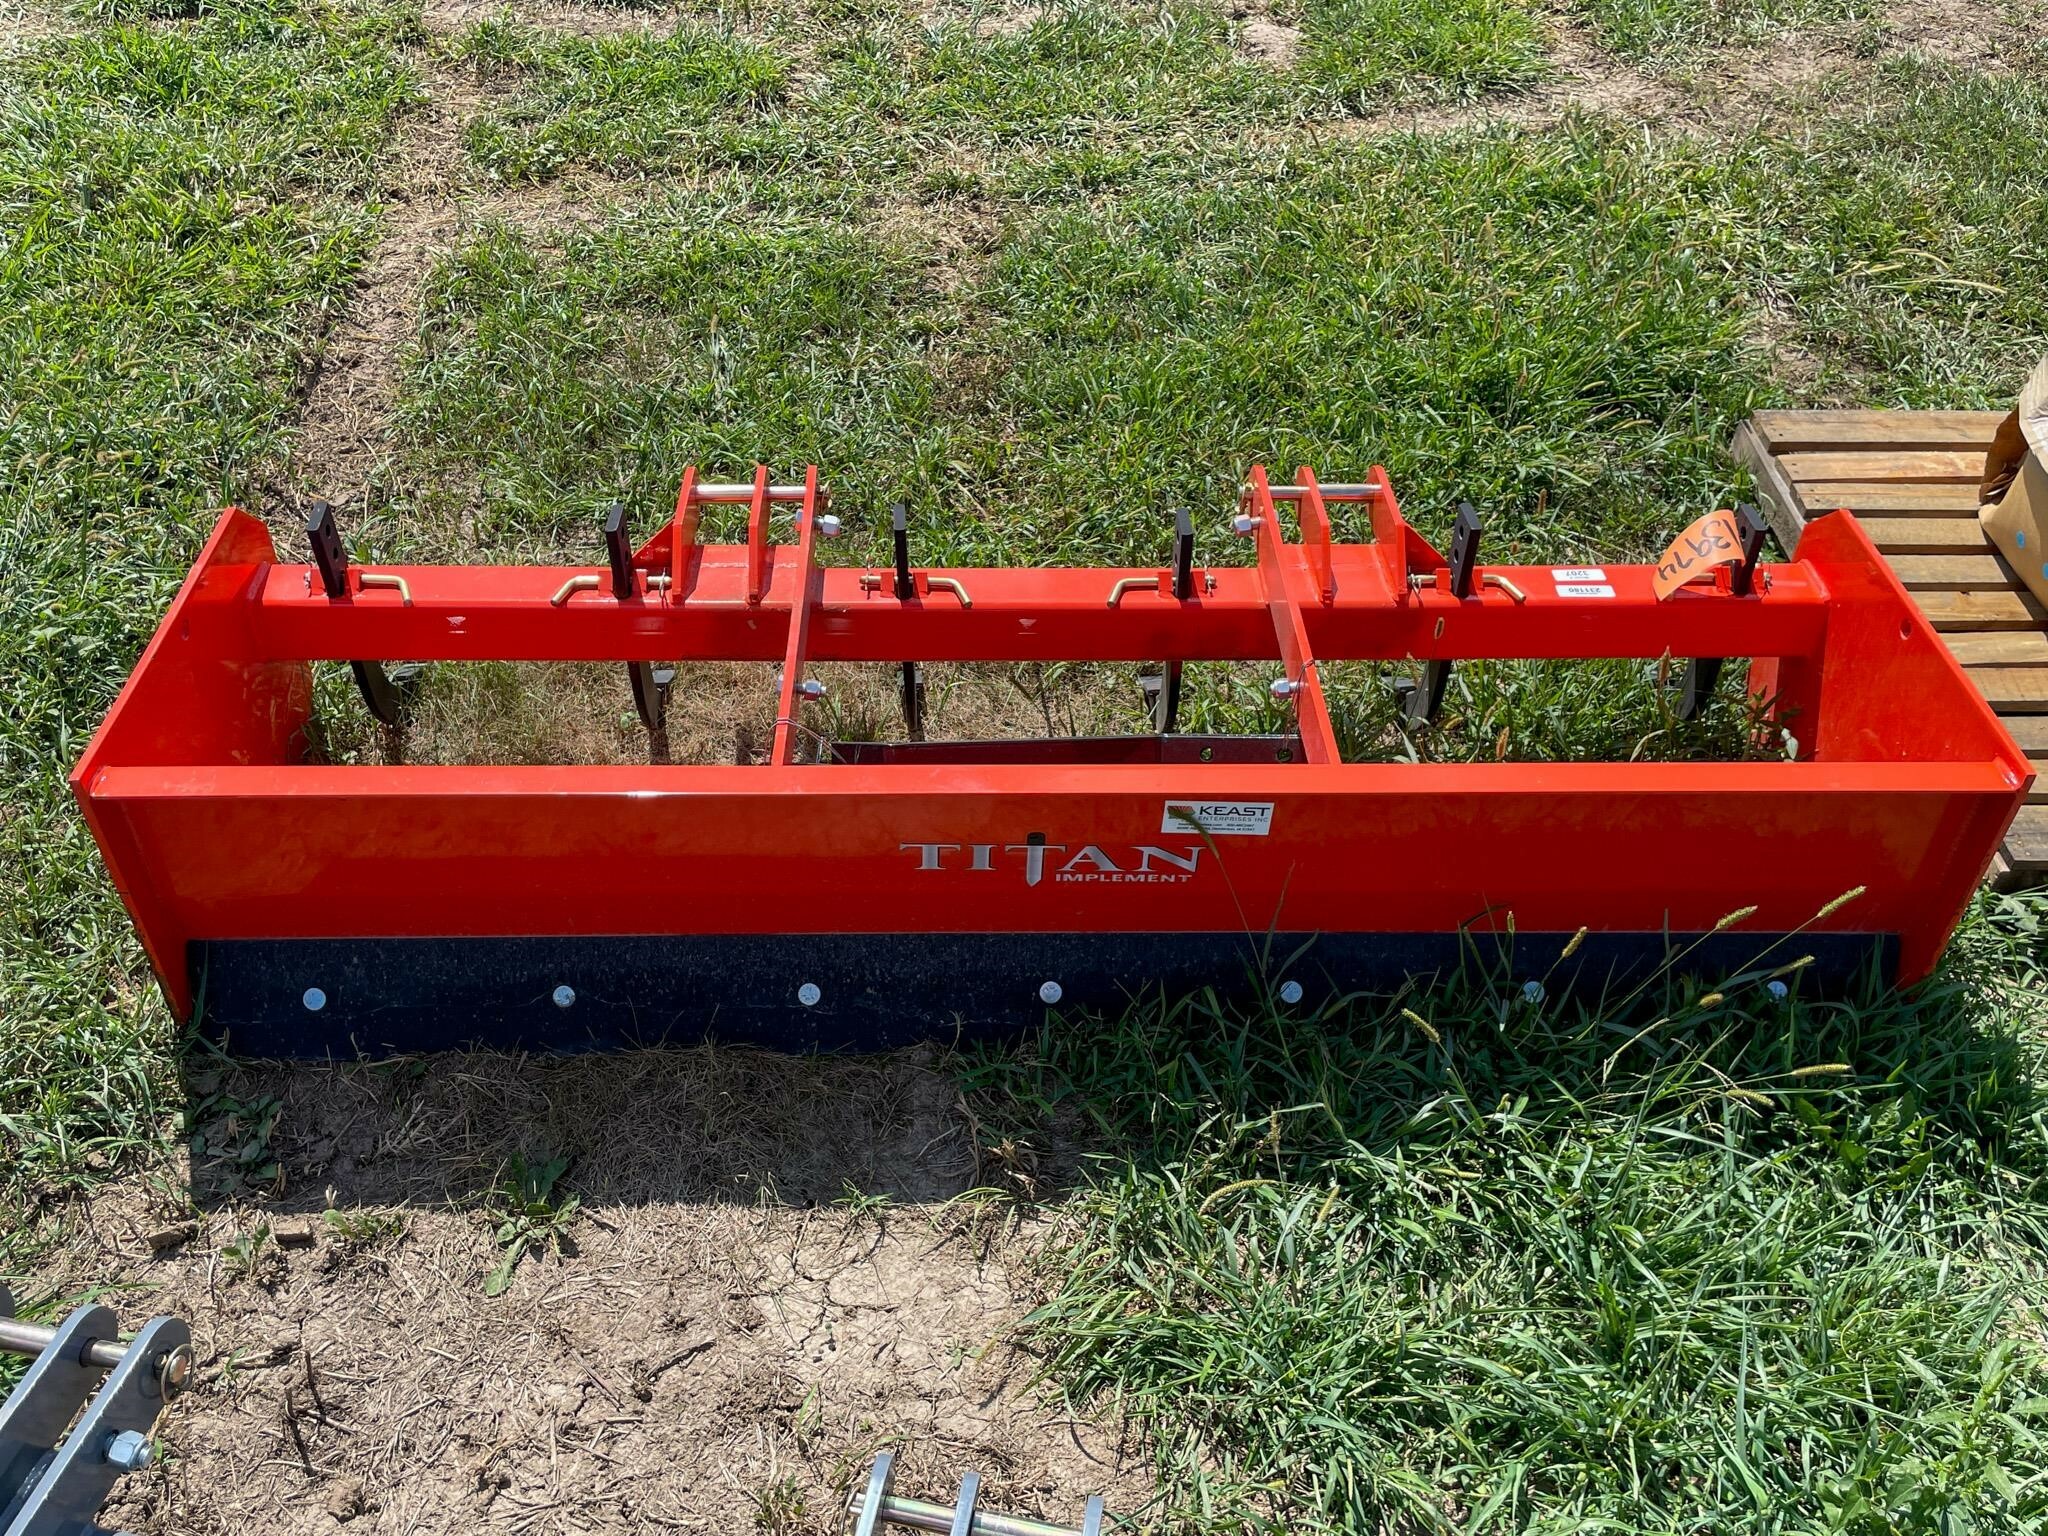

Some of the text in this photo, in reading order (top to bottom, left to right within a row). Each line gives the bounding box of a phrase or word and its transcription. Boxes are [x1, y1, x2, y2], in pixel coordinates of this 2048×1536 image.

[1657, 519, 1742, 581] 13974
[1200, 806, 1271, 817] KEAST
[899, 833, 1208, 887] TITAN
[1055, 873, 1193, 883] IMPLEMENT
